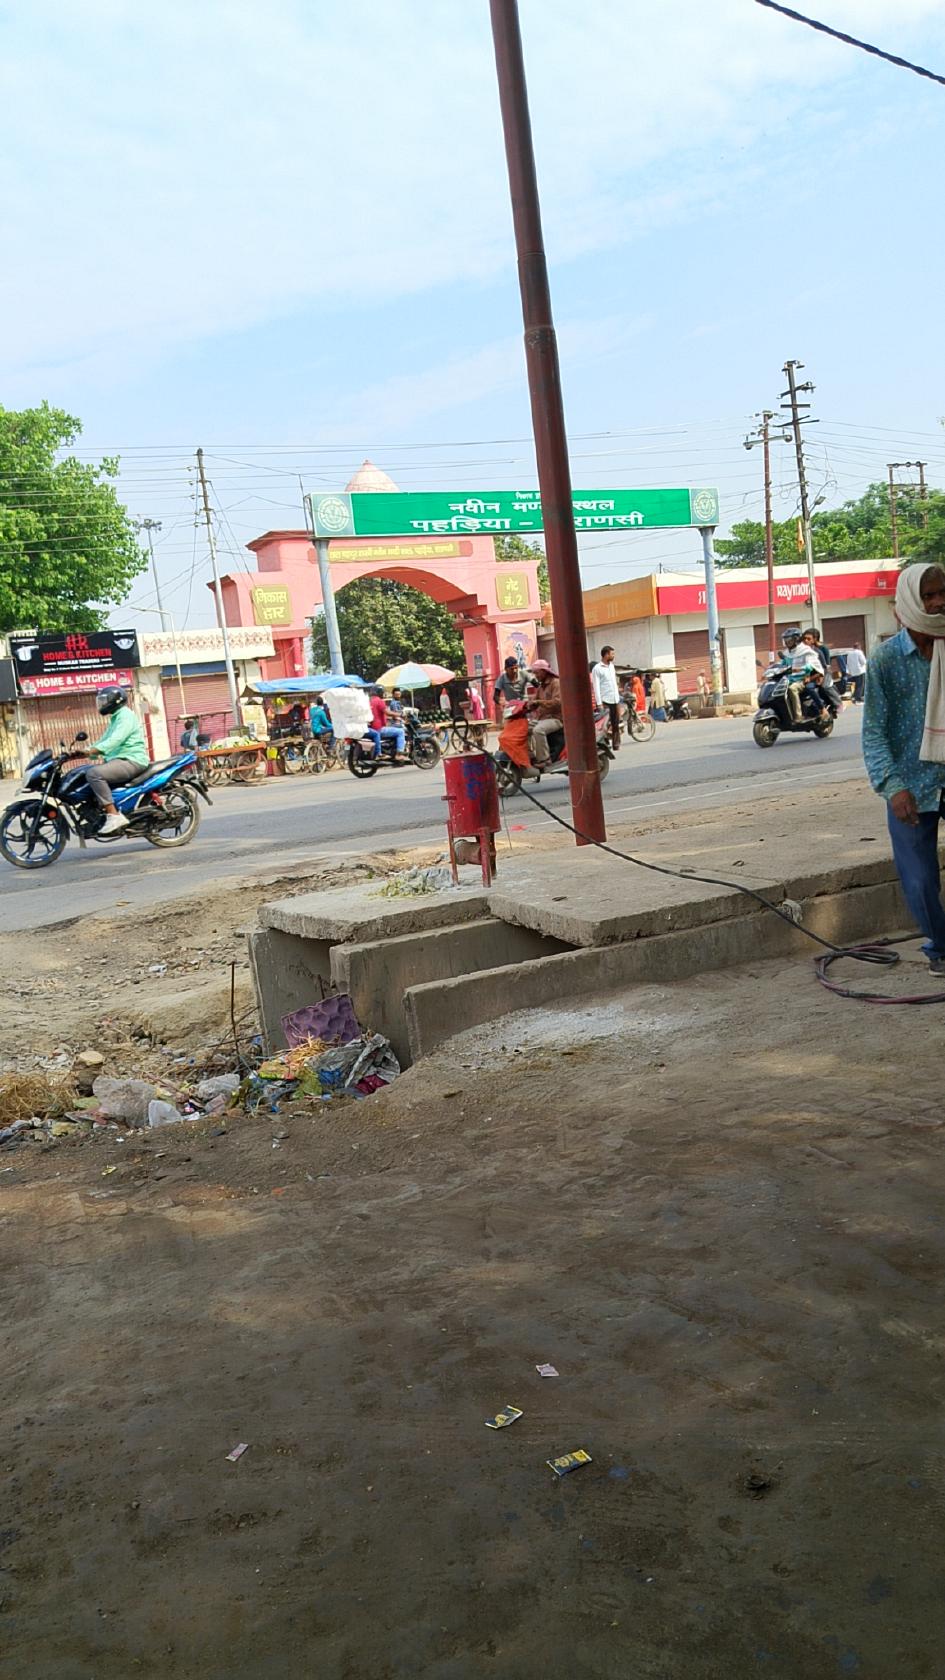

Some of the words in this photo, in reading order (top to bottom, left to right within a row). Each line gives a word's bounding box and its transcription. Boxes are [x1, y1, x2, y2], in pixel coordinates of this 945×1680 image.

[448, 499, 500, 514] नवीन
[409, 515, 511, 532] पहड़िया
[776, 582, 811, 601] Raymon
[42, 651, 68, 661] HOME
[76, 648, 112, 659] KITCHEN
[35, 676, 64, 688] HOME
[66, 675, 74, 685] &
[75, 672, 117, 684] KITCHEN
